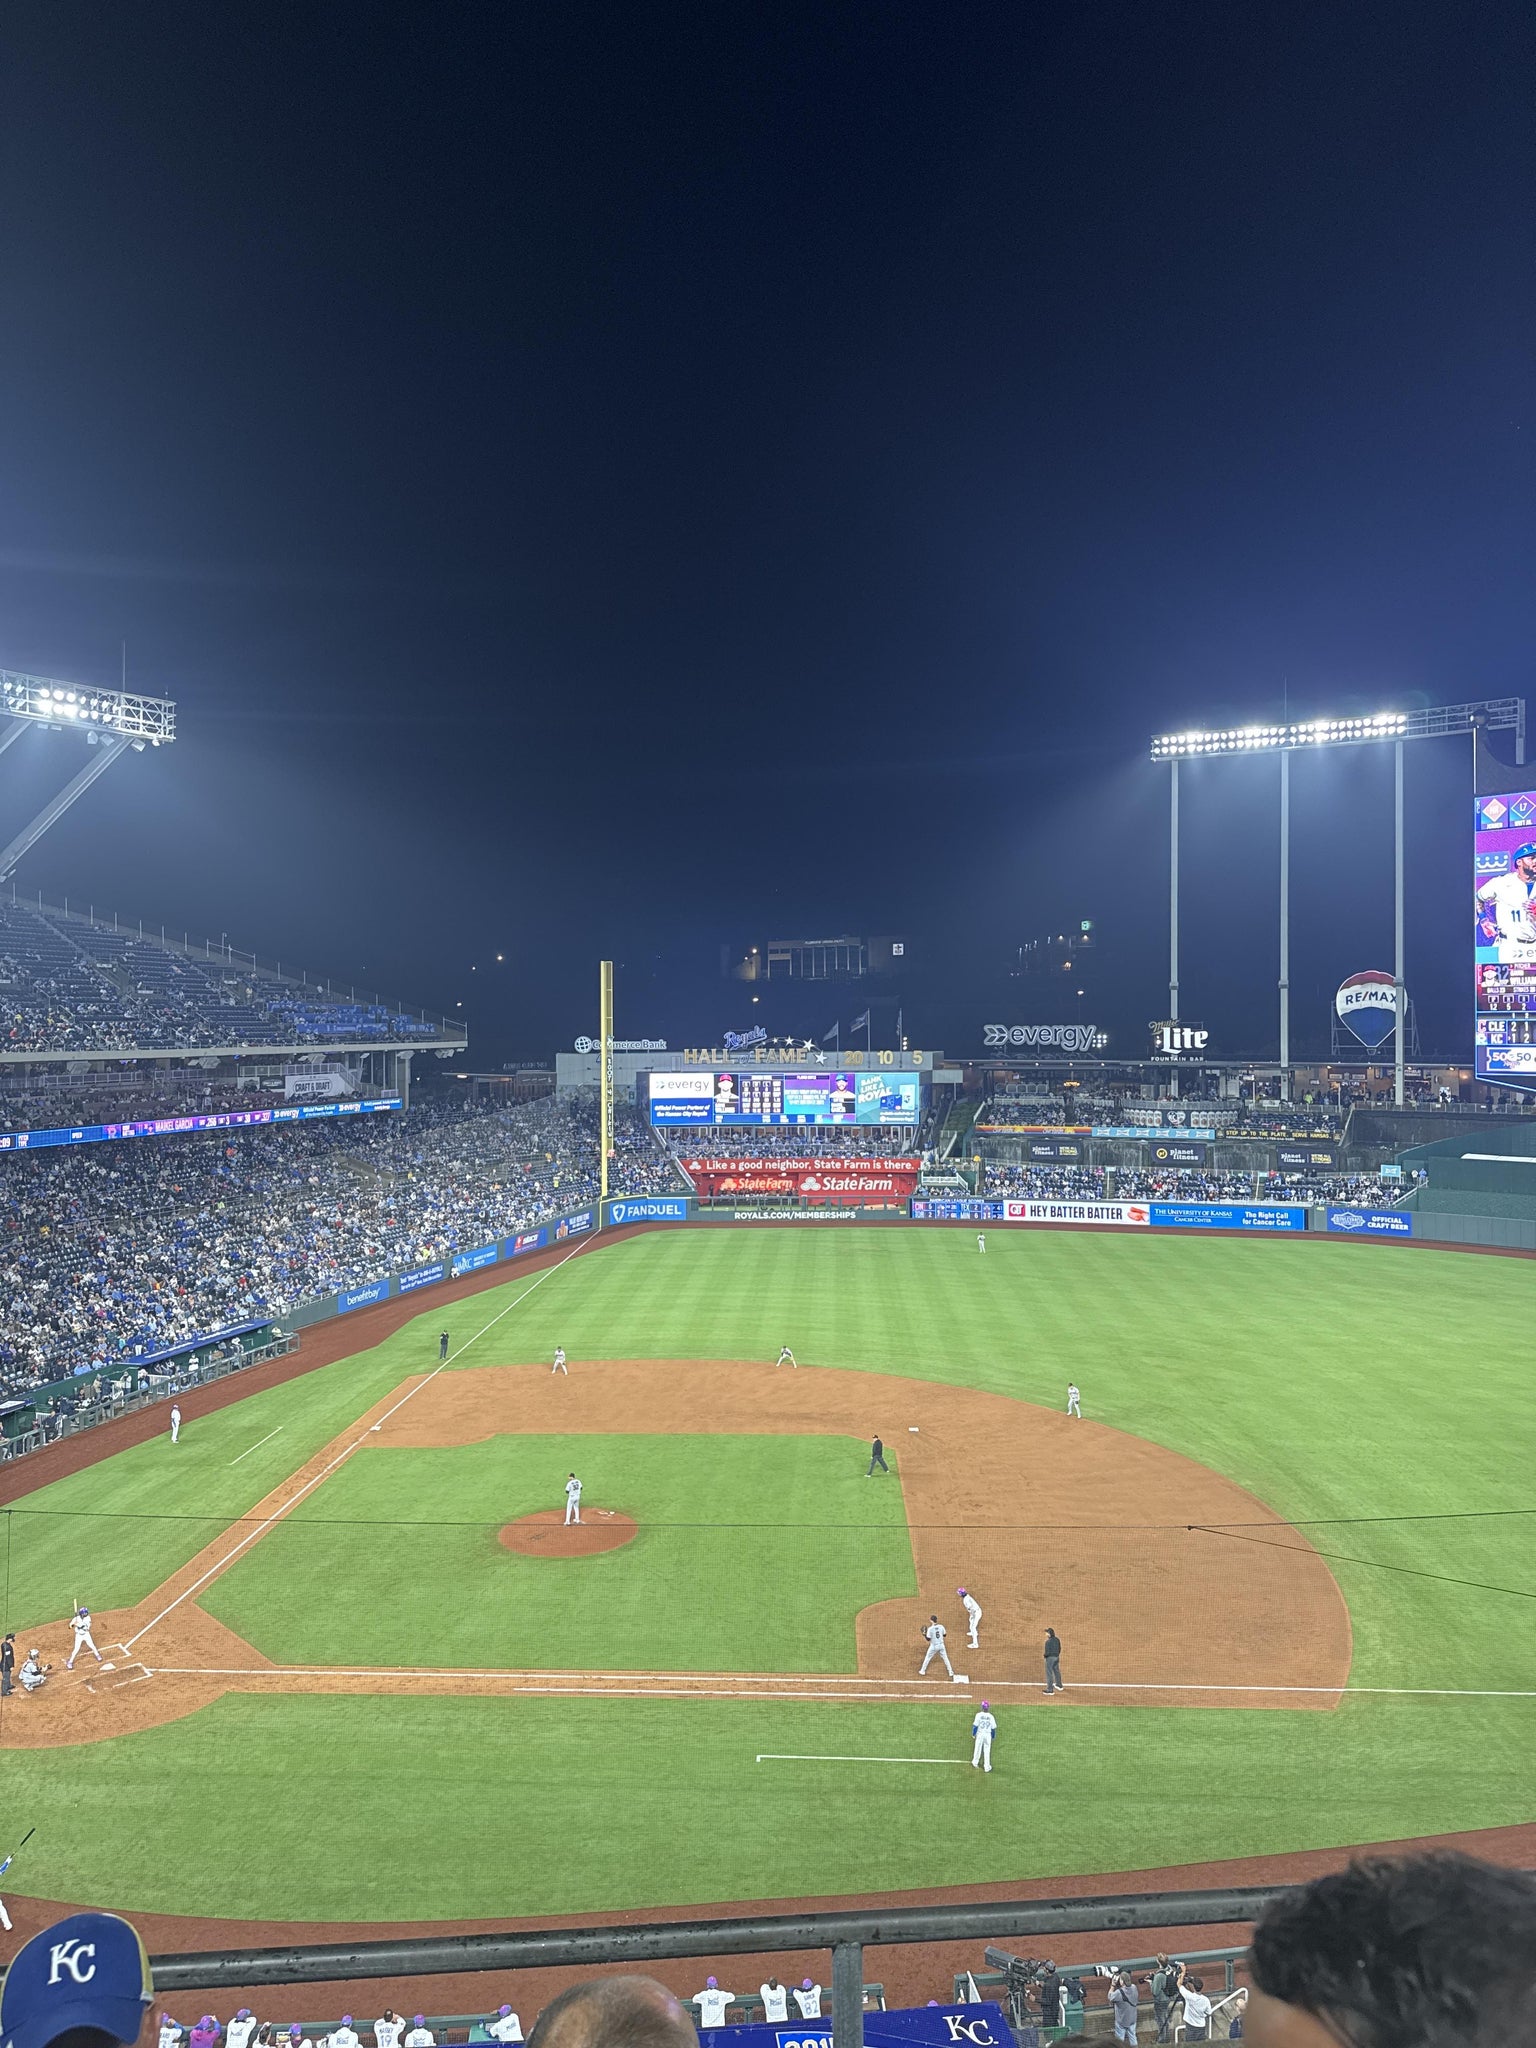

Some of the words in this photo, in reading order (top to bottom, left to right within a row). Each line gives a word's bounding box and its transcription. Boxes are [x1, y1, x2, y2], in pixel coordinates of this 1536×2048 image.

[1511, 910, 1521, 922] 11
[1345, 991, 1396, 1006] RE/MAX
[1148, 1020, 1180, 1035] Miller
[1488, 1021, 1505, 1032] CLE
[1511, 1022, 1517, 1032] 2
[1524, 1022, 1529, 1032] 1
[724, 1025, 768, 1050] Royals
[1011, 1026, 1095, 1051] evergy
[1161, 1027, 1209, 1055] Lite
[1490, 1034, 1503, 1044] KC
[1511, 1033, 1516, 1044] 1
[1523, 1033, 1530, 1044] 2
[642, 1039, 667, 1049] Bank
[684, 1048, 735, 1064] HALL
[754, 1048, 808, 1064] FAME
[844, 1051, 864, 1065] 20
[877, 1050, 894, 1065] 10
[912, 1051, 923, 1065] 5
[668, 1080, 710, 1091] evergy
[861, 1075, 882, 1086] BANK
[294, 1082, 311, 1092] CRAFT
[857, 1086, 893, 1104] ROYAL
[1169, 1148, 1194, 1156] planet
[706, 1160, 728, 1170] Like
[738, 1160, 763, 1172] good
[765, 1160, 811, 1171] neighbor,
[814, 1160, 842, 1170] State
[844, 1160, 871, 1170] Farm
[873, 1160, 882, 1170] is
[884, 1160, 915, 1170] there.
[627, 1205, 682, 1217] FANDUEL
[734, 1211, 857, 1220] ROYALS.COM/MEMBERSHIPS
[1010, 1205, 1025, 1216] QT
[1030, 1205, 1045, 1217] HEY
[1050, 1205, 1085, 1219] BATTER
[1087, 1206, 1122, 1220] BATTER
[1167, 1208, 1200, 1216] UNIVERSITY
[1258, 1211, 1275, 1220] Right
[1371, 1216, 1403, 1224] OFFICIAL
[1390, 1223, 1409, 1231] BEER
[346, 1287, 381, 1305] benefitbay
[47, 1938, 96, 1985] KC
[805, 2001, 819, 2015] 82
[942, 2015, 994, 2046] KC
[380, 2035, 392, 2048] 19
